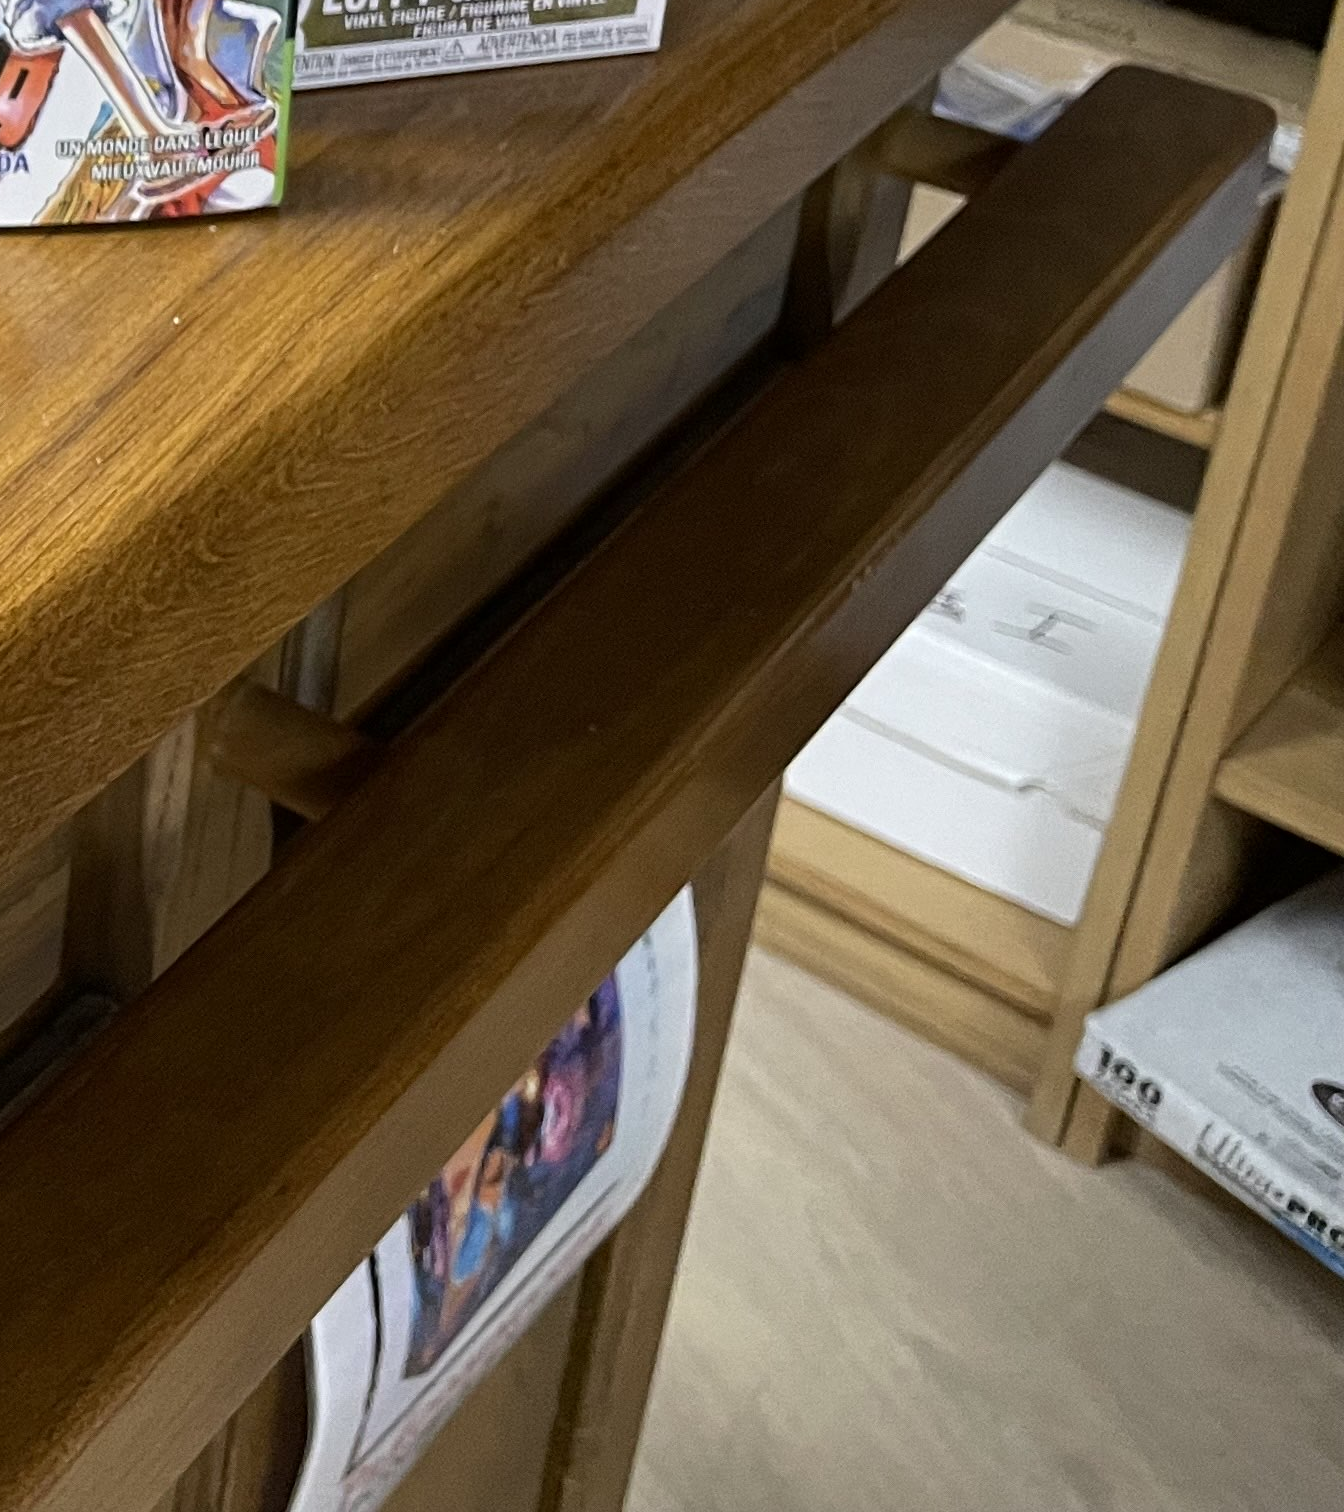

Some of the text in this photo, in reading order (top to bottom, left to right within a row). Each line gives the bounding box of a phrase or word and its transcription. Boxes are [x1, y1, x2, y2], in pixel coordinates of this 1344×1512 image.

[343, 11, 388, 31] VINYL
[391, 5, 446, 26] FIGURE
[56, 140, 82, 159] UN
[86, 135, 149, 156] MONDE
[153, 133, 200, 153] DANS
